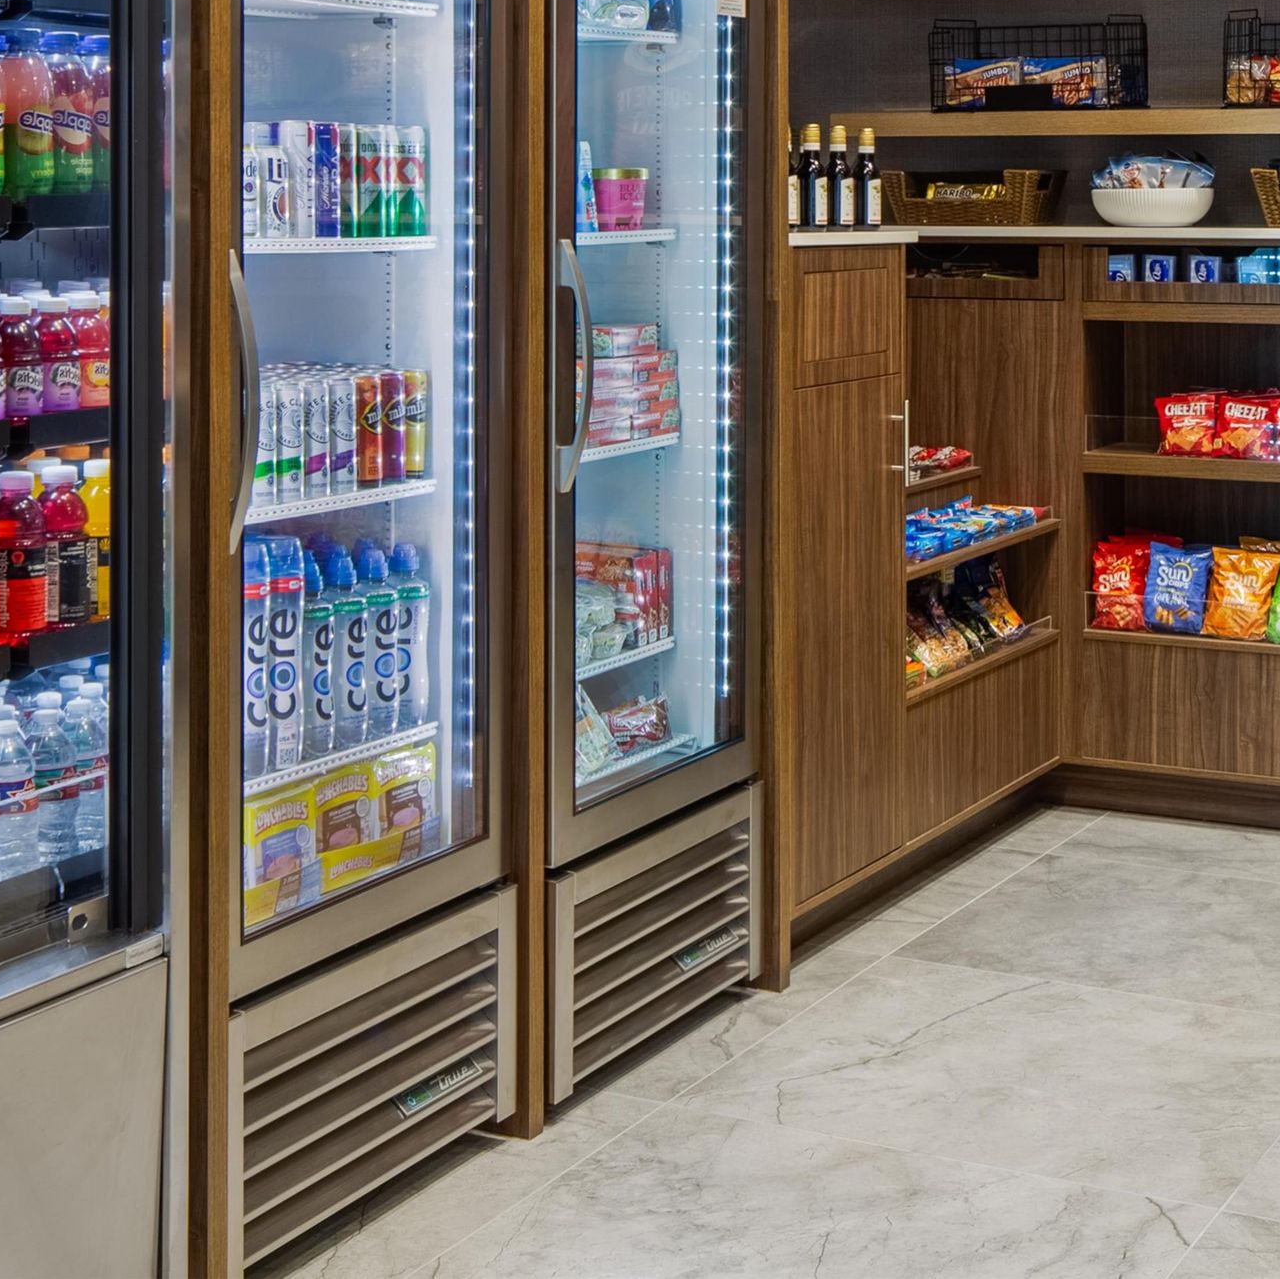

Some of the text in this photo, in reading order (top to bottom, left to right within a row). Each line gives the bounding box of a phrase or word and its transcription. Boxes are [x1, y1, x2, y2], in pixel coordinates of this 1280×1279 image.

[982, 66, 1009, 79] JUMBO
[935, 187, 973, 199] HARIBO
[1098, 570, 1131, 591] Sun
[1156, 565, 1191, 586] Sun
[1169, 580, 1189, 589] CHIPS
[270, 608, 297, 720] core
[346, 616, 367, 712] core
[374, 609, 397, 702] core
[248, 615, 268, 728] core
[314, 623, 335, 720] core
[255, 801, 309, 831] LUNCHABLES
[330, 856, 373, 879] LUNCHABLES
